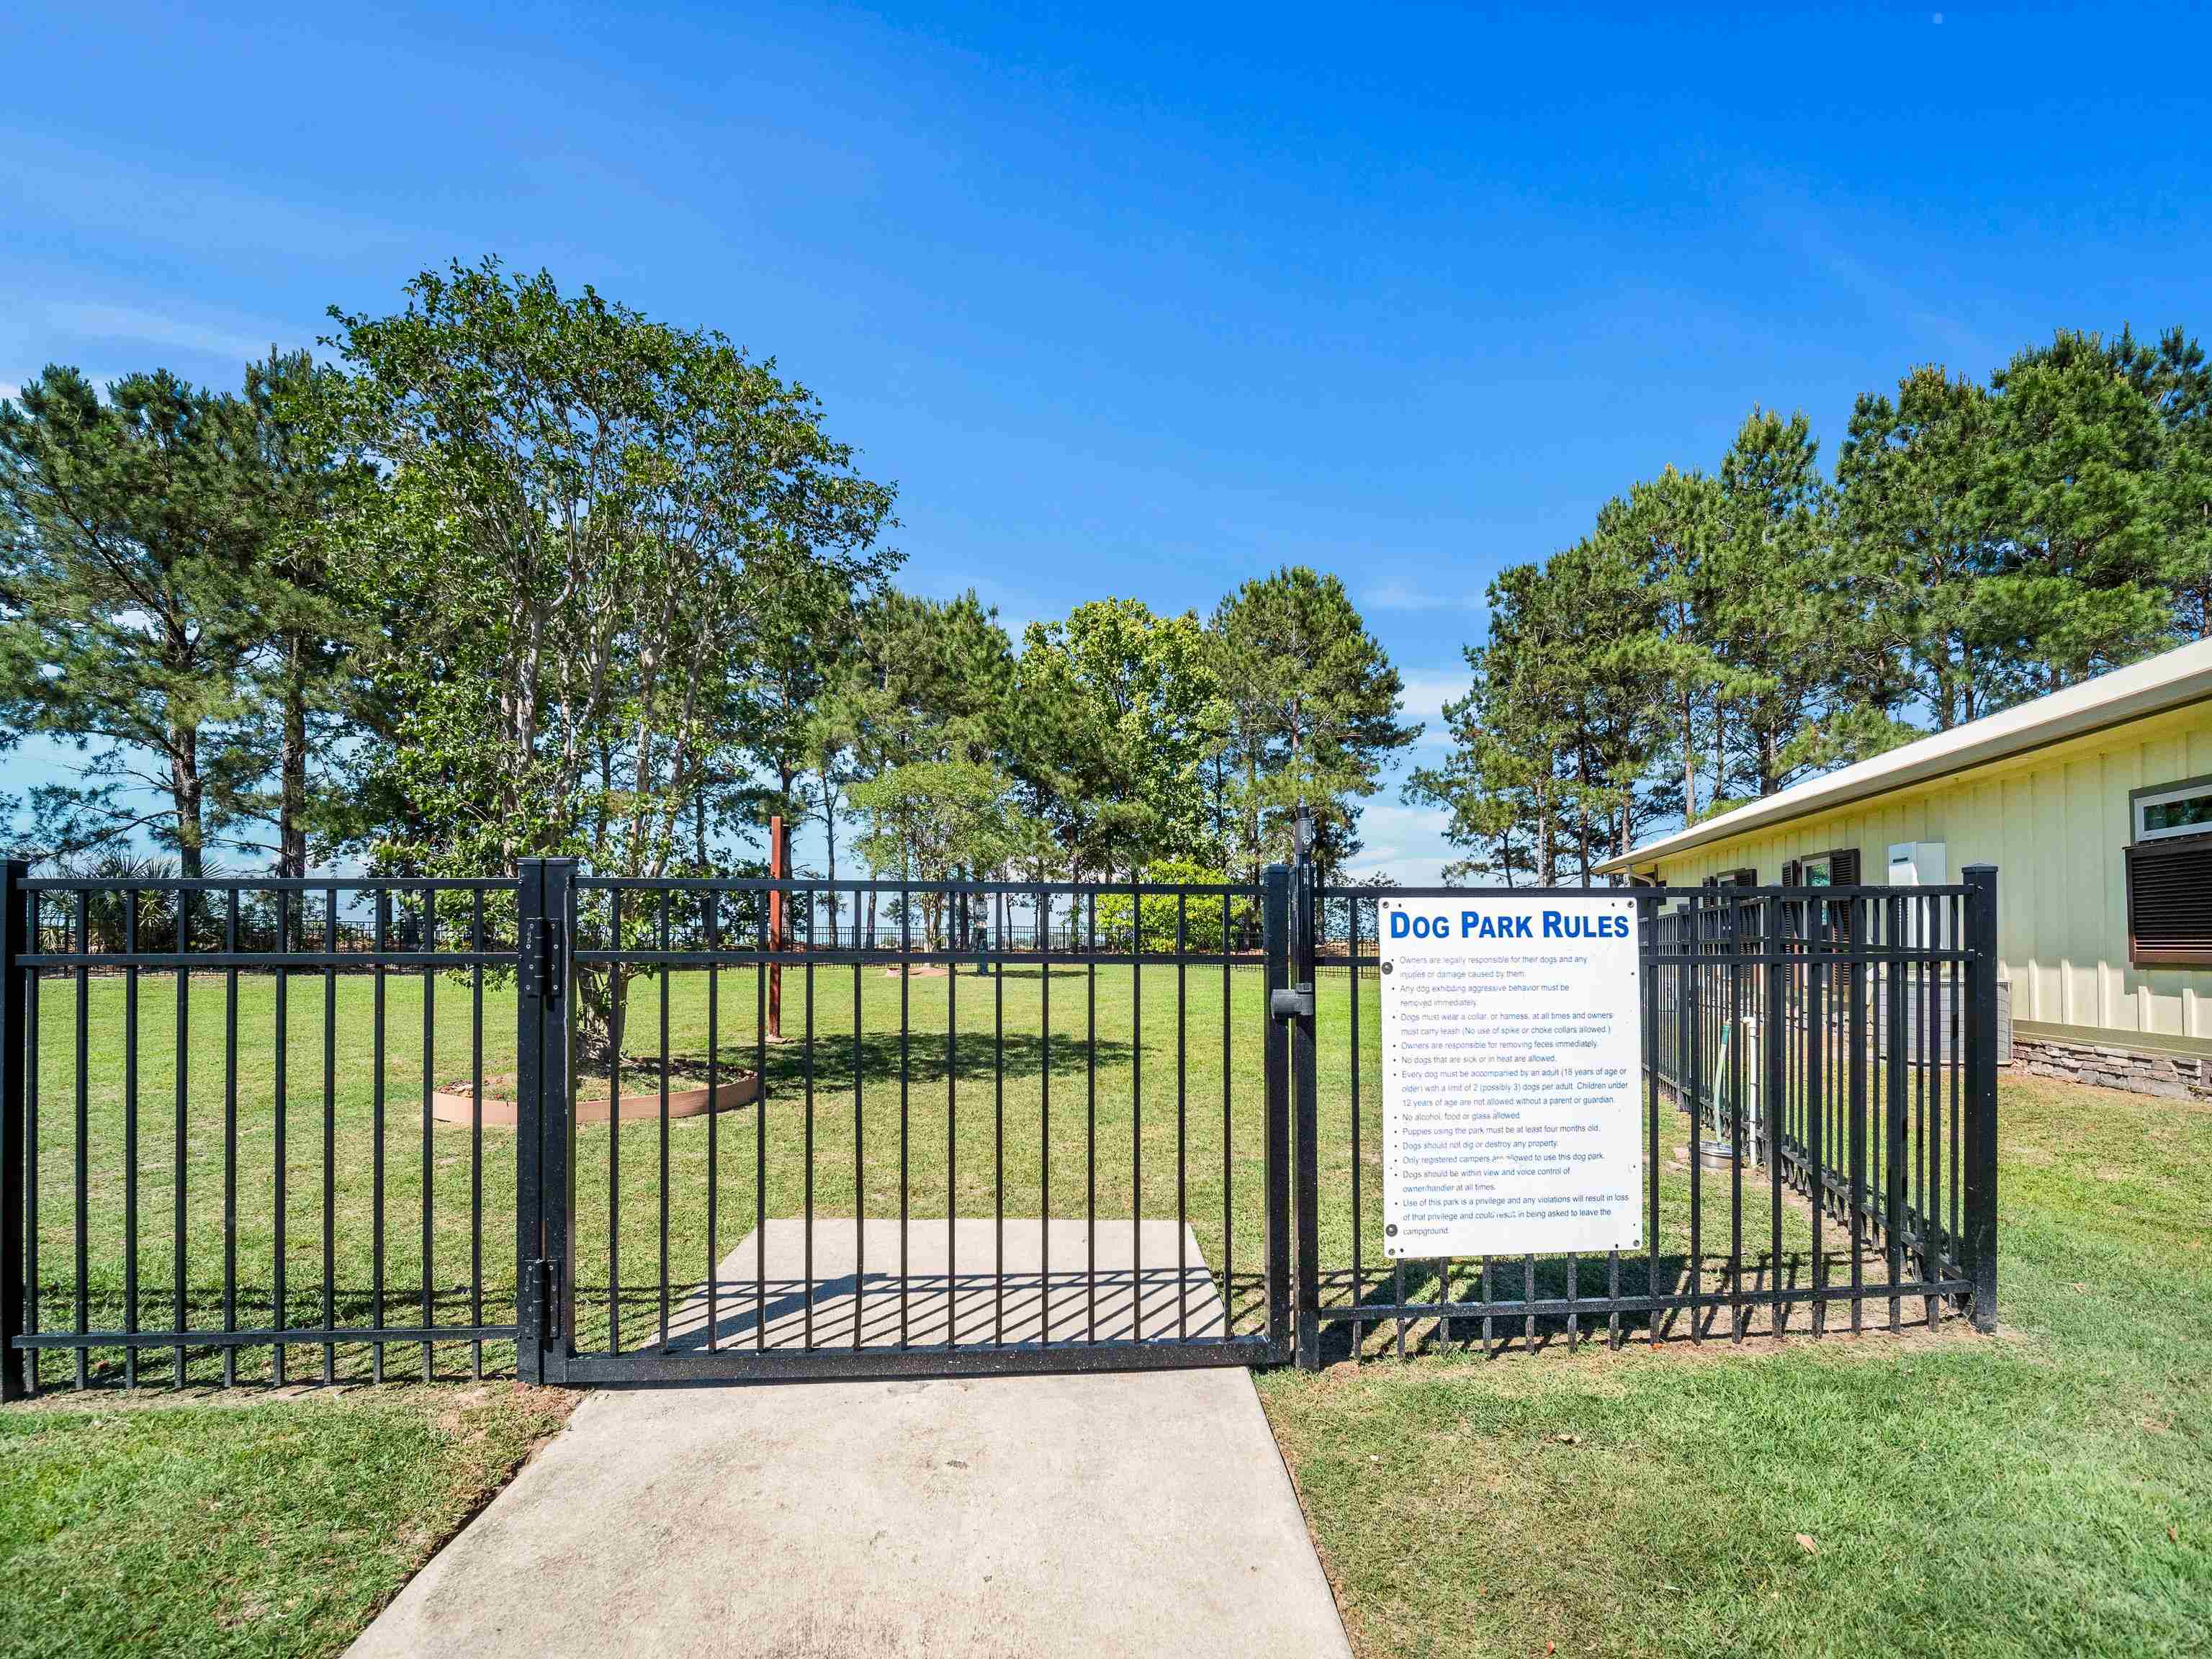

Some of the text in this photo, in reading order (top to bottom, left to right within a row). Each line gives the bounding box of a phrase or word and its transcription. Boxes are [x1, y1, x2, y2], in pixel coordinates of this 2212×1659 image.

[1390, 910, 1629, 938] DOG PARK RULES
[1467, 955, 1509, 965] responsible
[1539, 955, 1557, 964] dogs
[1436, 969, 1466, 979] damage
[1495, 969, 1505, 979] by
[1399, 984, 1414, 994] Any
[1416, 984, 1430, 994] dog
[1467, 983, 1507, 993] aggressive
[1400, 1012, 1420, 1022] Dogs
[1550, 1011, 1571, 1020] times
[1501, 1026, 1520, 1035] spike
[1444, 1040, 1486, 1050] responsible
[1487, 1040, 1498, 1048] for
[1499, 1040, 1532, 1050] removing
[1413, 1055, 1432, 1065] dogs
[1496, 1054, 1513, 1063] heat
[1401, 1069, 1422, 1079] Every
[1424, 1069, 1438, 1079] dog
[1439, 1069, 1457, 1077] must
[1470, 1068, 1519, 1079] accompanied
[1519, 1068, 1529, 1078] by
[1603, 1069, 1619, 1077] age
[1521, 1082, 1540, 1092] dogs
[1576, 1081, 1606, 1089] Children
[1434, 1097, 1442, 1106] of
[1486, 1097, 1514, 1105] allowed
[1548, 1096, 1573, 1106] parent
[1471, 1111, 1491, 1121] glass
[1402, 1126, 1432, 1136] Puppies
[1433, 1126, 1453, 1136] using
[1455, 1125, 1467, 1134] the
[1467, 1125, 1485, 1136] park
[1505, 1125, 1515, 1133] be
[1543, 1124, 1558, 1133] four
[1402, 1141, 1421, 1150] Dogs
[1423, 1140, 1447, 1148] should
[1462, 1140, 1474, 1149] dig
[1484, 1139, 1511, 1149] destroy
[1512, 1141, 1527, 1149] any
[1402, 1155, 1420, 1165] Only
[1421, 1154, 1457, 1164] registered
[1557, 1152, 1571, 1161] this
[1571, 1152, 1586, 1162] dog
[1402, 1169, 1422, 1179] Dogs
[1423, 1169, 1448, 1177] should
[1460, 1168, 1482, 1177] within
[1501, 1167, 1515, 1176] and
[1537, 1166, 1562, 1175] control
[1464, 1182, 1473, 1191] all
[1402, 1197, 1418, 1206] Use
[1442, 1197, 1459, 1207] park
[1475, 1196, 1506, 1206] privilege
[1506, 1195, 1521, 1204] and
[1522, 1197, 1536, 1205] any
[1537, 1195, 1571, 1203] violations
[1571, 1194, 1584, 1202] will
[1584, 1193, 1606, 1202] result
[1427, 1211, 1458, 1221] privilege
[1459, 1210, 1473, 1219] and
[1525, 1209, 1547, 1219] being
[1570, 1208, 1578, 1217] to
